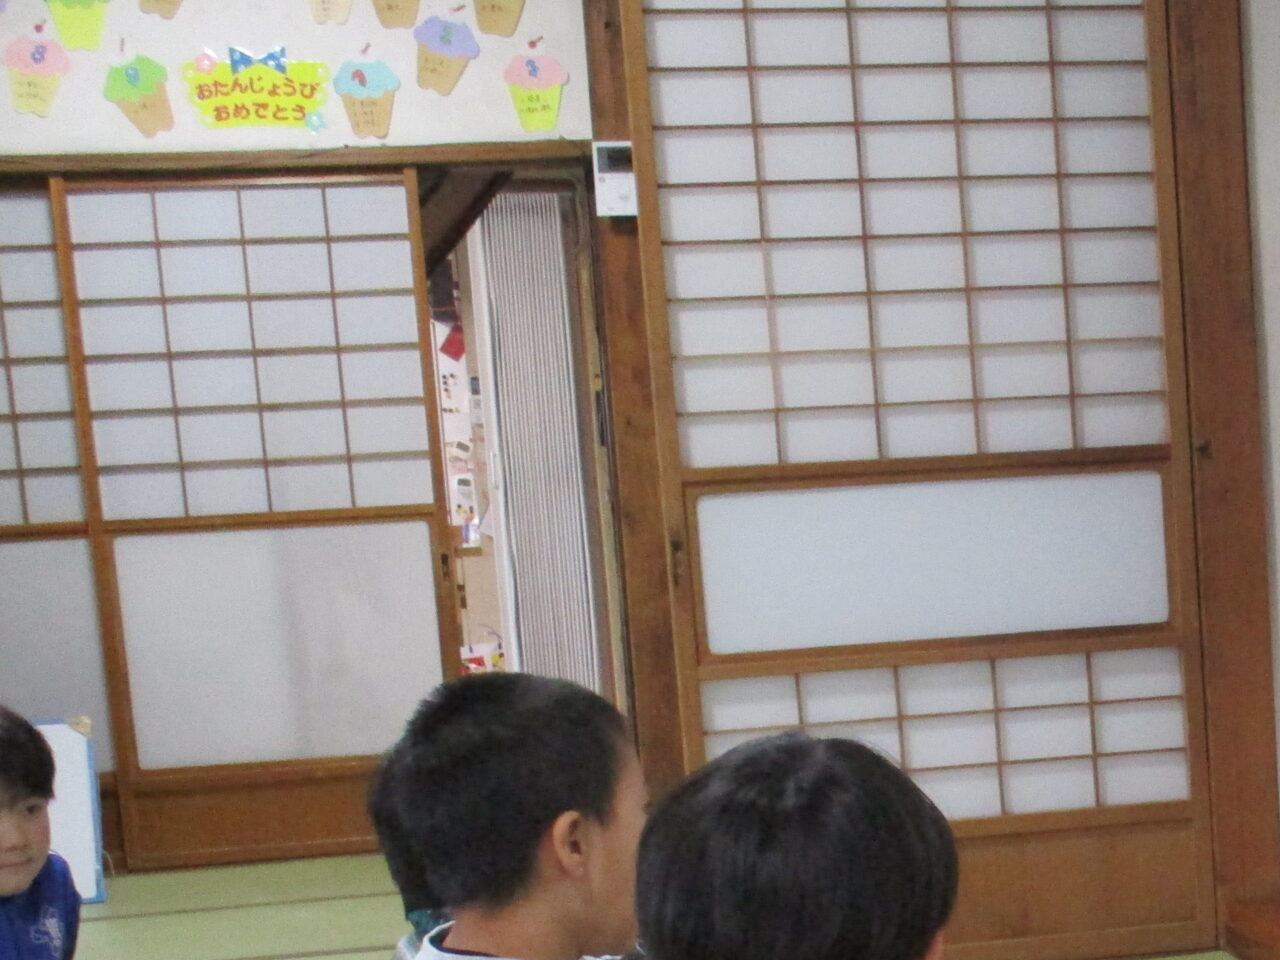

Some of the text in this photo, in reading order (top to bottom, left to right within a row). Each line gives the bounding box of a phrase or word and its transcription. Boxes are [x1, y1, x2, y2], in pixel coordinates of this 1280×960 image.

[196, 76, 319, 100] おたんじょうび
[213, 102, 306, 122] おめでとう
